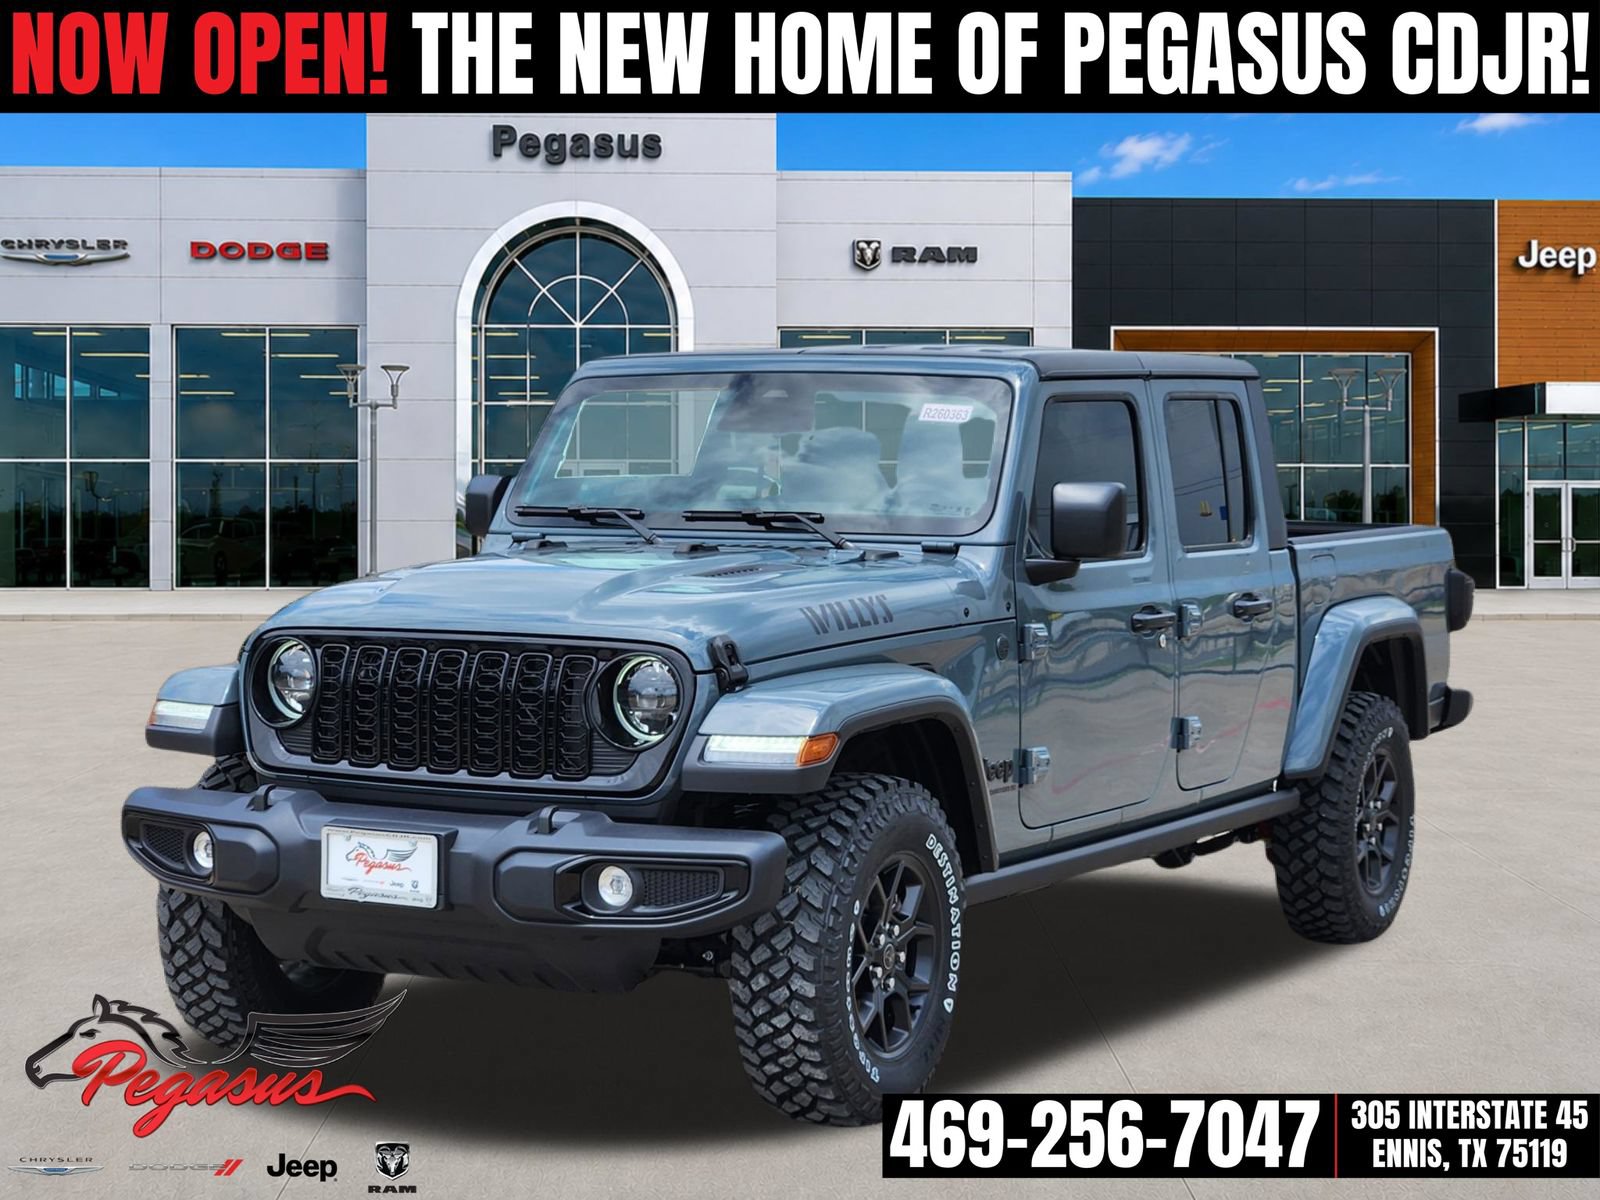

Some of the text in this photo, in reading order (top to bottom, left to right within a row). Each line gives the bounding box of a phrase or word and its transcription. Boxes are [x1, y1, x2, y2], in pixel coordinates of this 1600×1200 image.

[492, 124, 662, 165] Pegasus
[0, 239, 129, 250] CHRYSLER
[190, 241, 328, 260] DODGE
[891, 246, 978, 264] RAM
[1518, 239, 1596, 275] Jeep
[800, 594, 893, 635] WILLYS
[354, 851, 412, 875] Pegasus
[926, 834, 961, 992] DESTINATION
